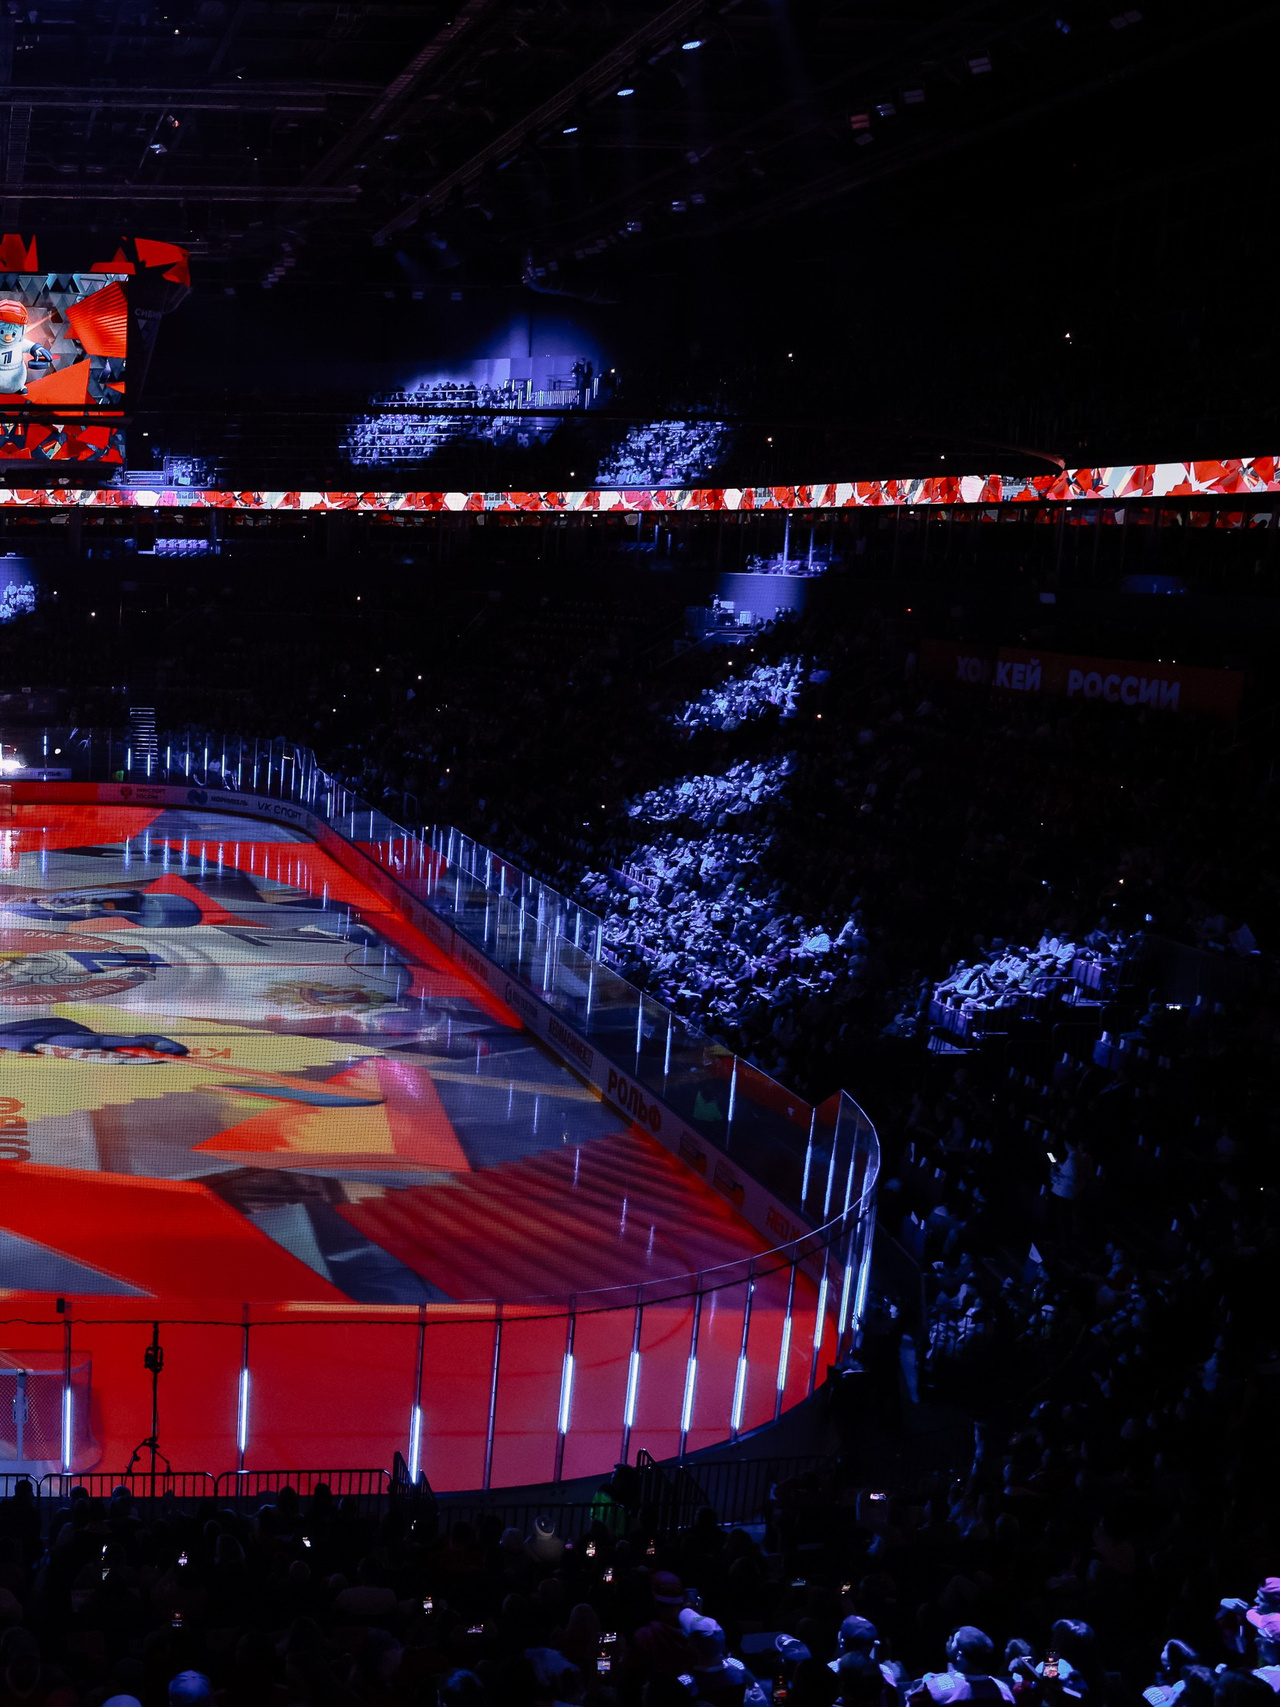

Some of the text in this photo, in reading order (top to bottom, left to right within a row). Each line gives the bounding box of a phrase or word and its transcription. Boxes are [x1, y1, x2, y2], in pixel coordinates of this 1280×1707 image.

[1067, 669, 1182, 713] РОССИИ
[257, 801, 302, 820] VK СПОРТ
[24, 931, 63, 940] ONE
[66, 936, 105, 946] CUP
[608, 1068, 662, 1132] РОЛЬФ
